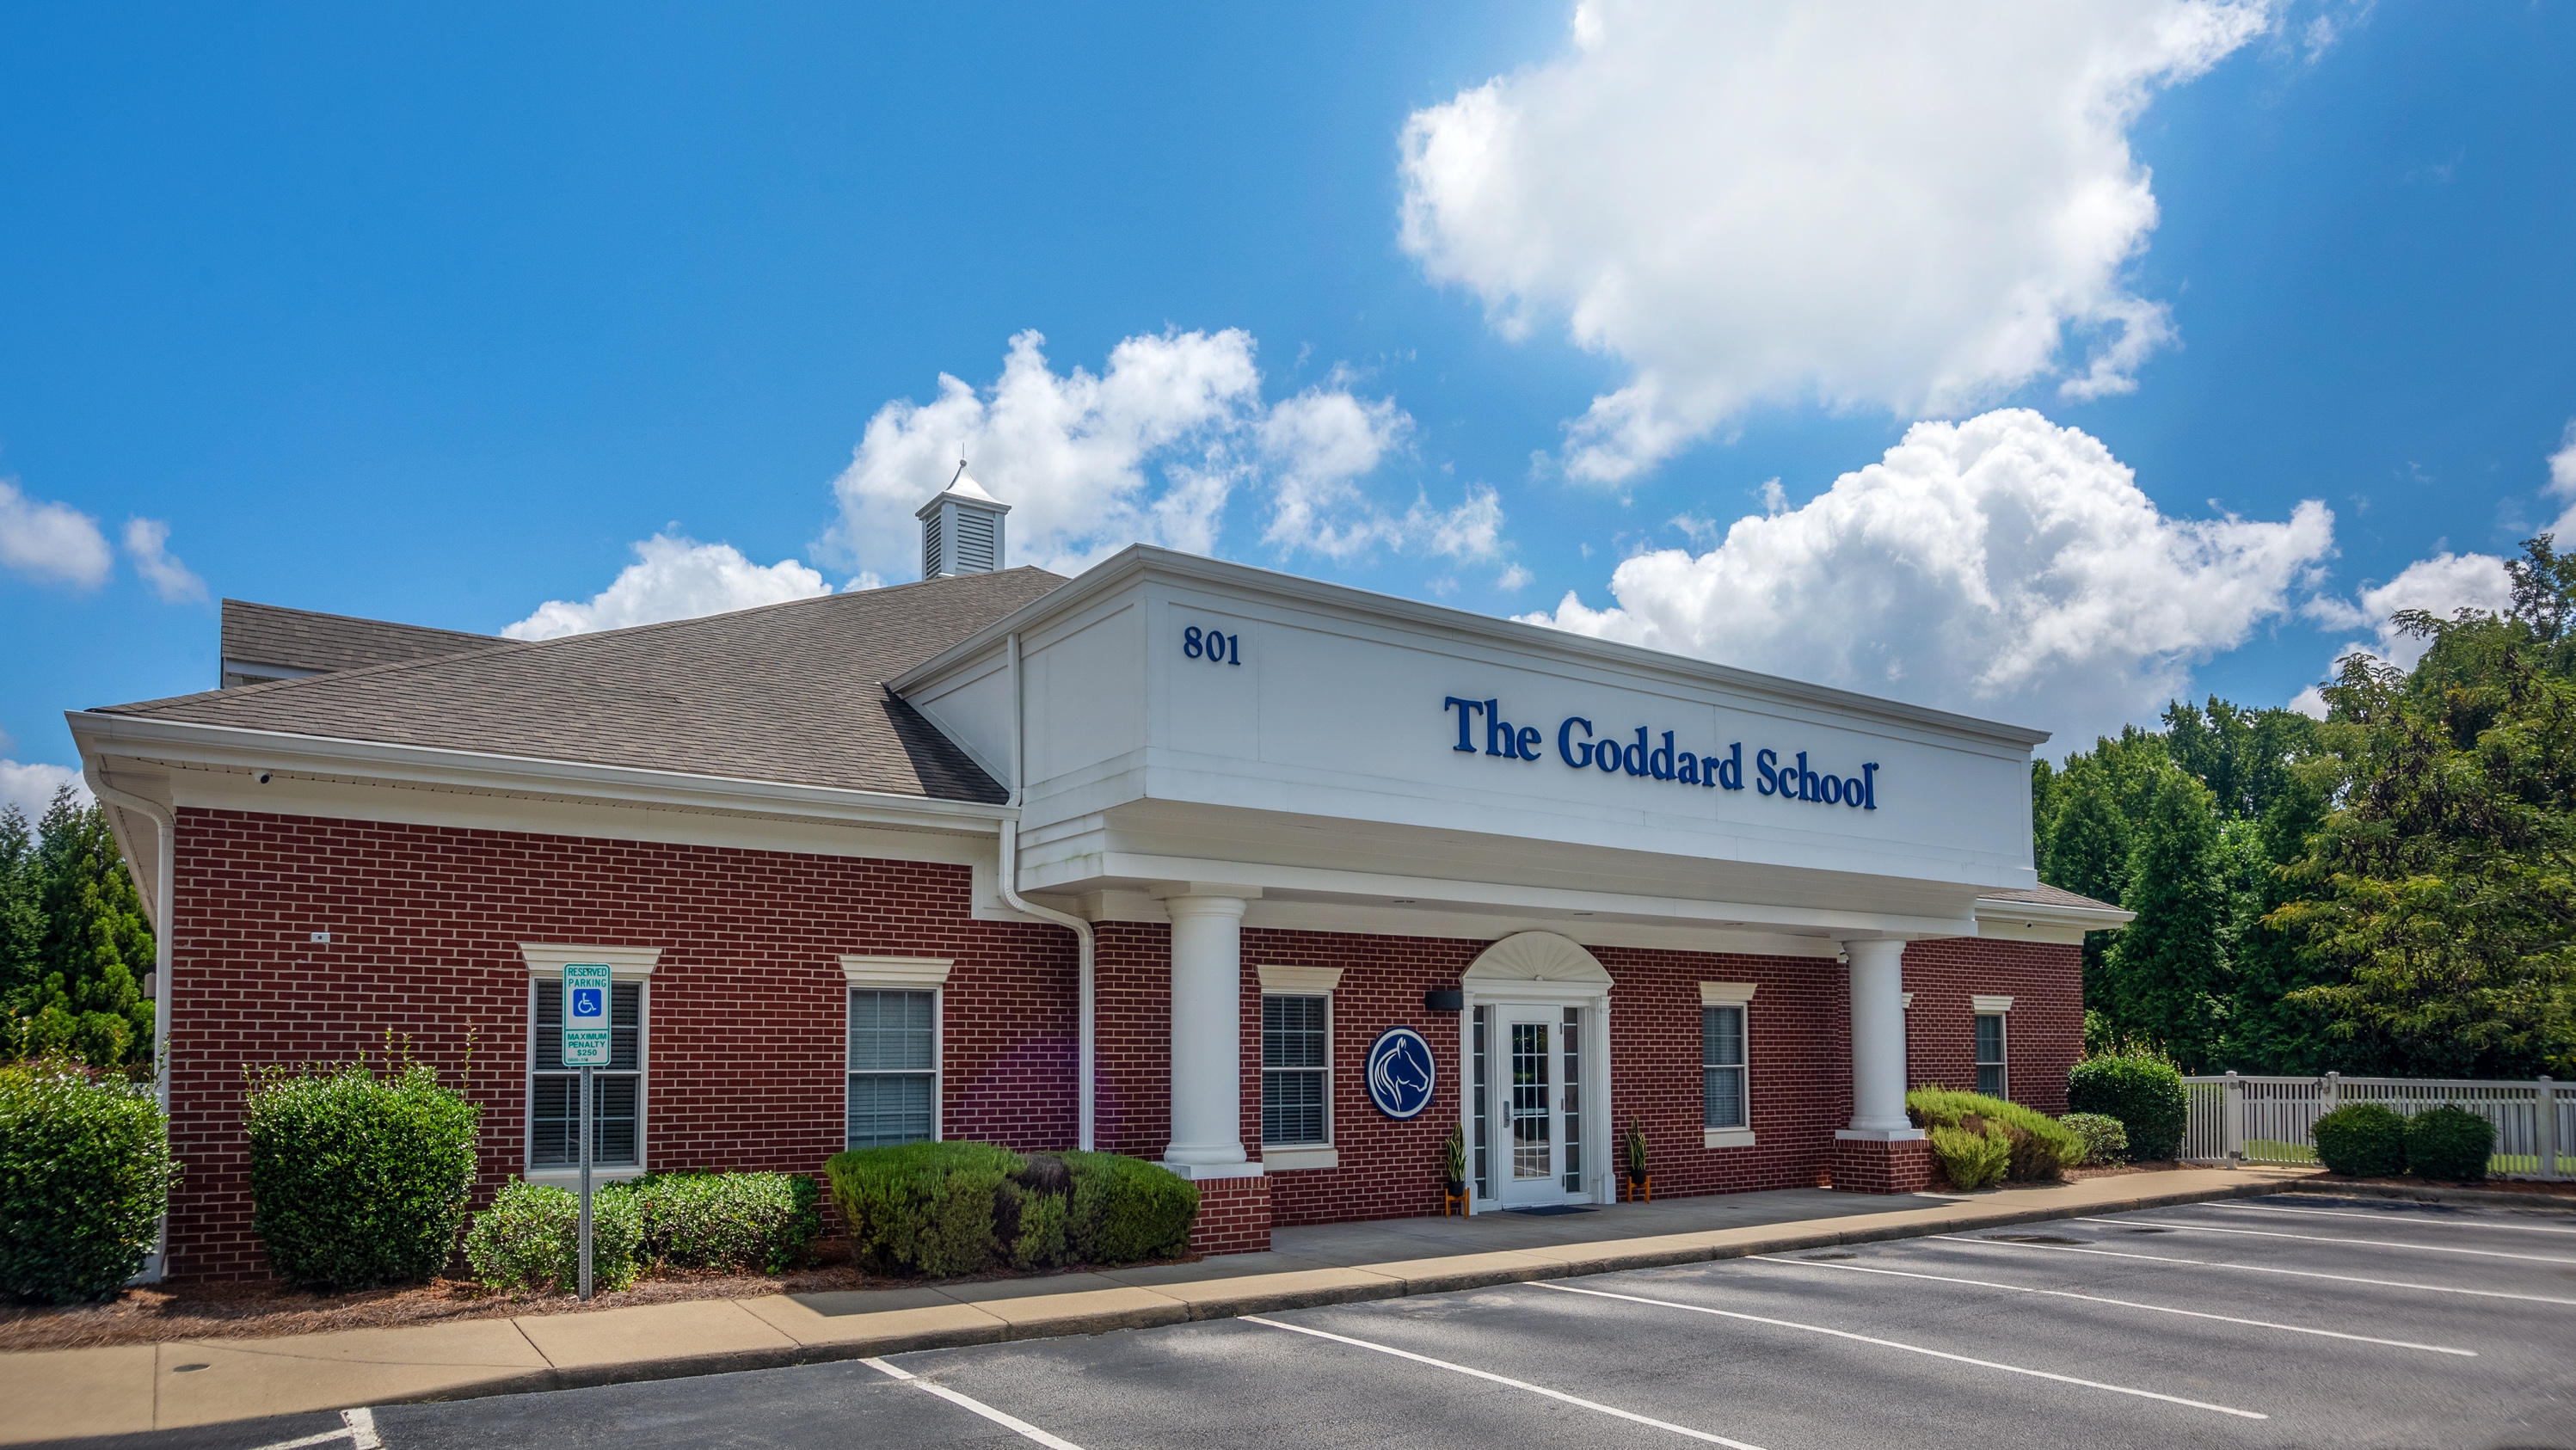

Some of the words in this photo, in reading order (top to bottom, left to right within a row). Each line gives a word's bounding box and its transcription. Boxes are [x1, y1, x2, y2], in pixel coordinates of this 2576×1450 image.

[1183, 625, 1240, 665] 801
[1444, 696, 1541, 760] The
[1559, 716, 1744, 790] Goddard
[1756, 748, 1879, 809] School
[568, 968, 607, 977] RESERVED
[568, 979, 607, 988] PARKING
